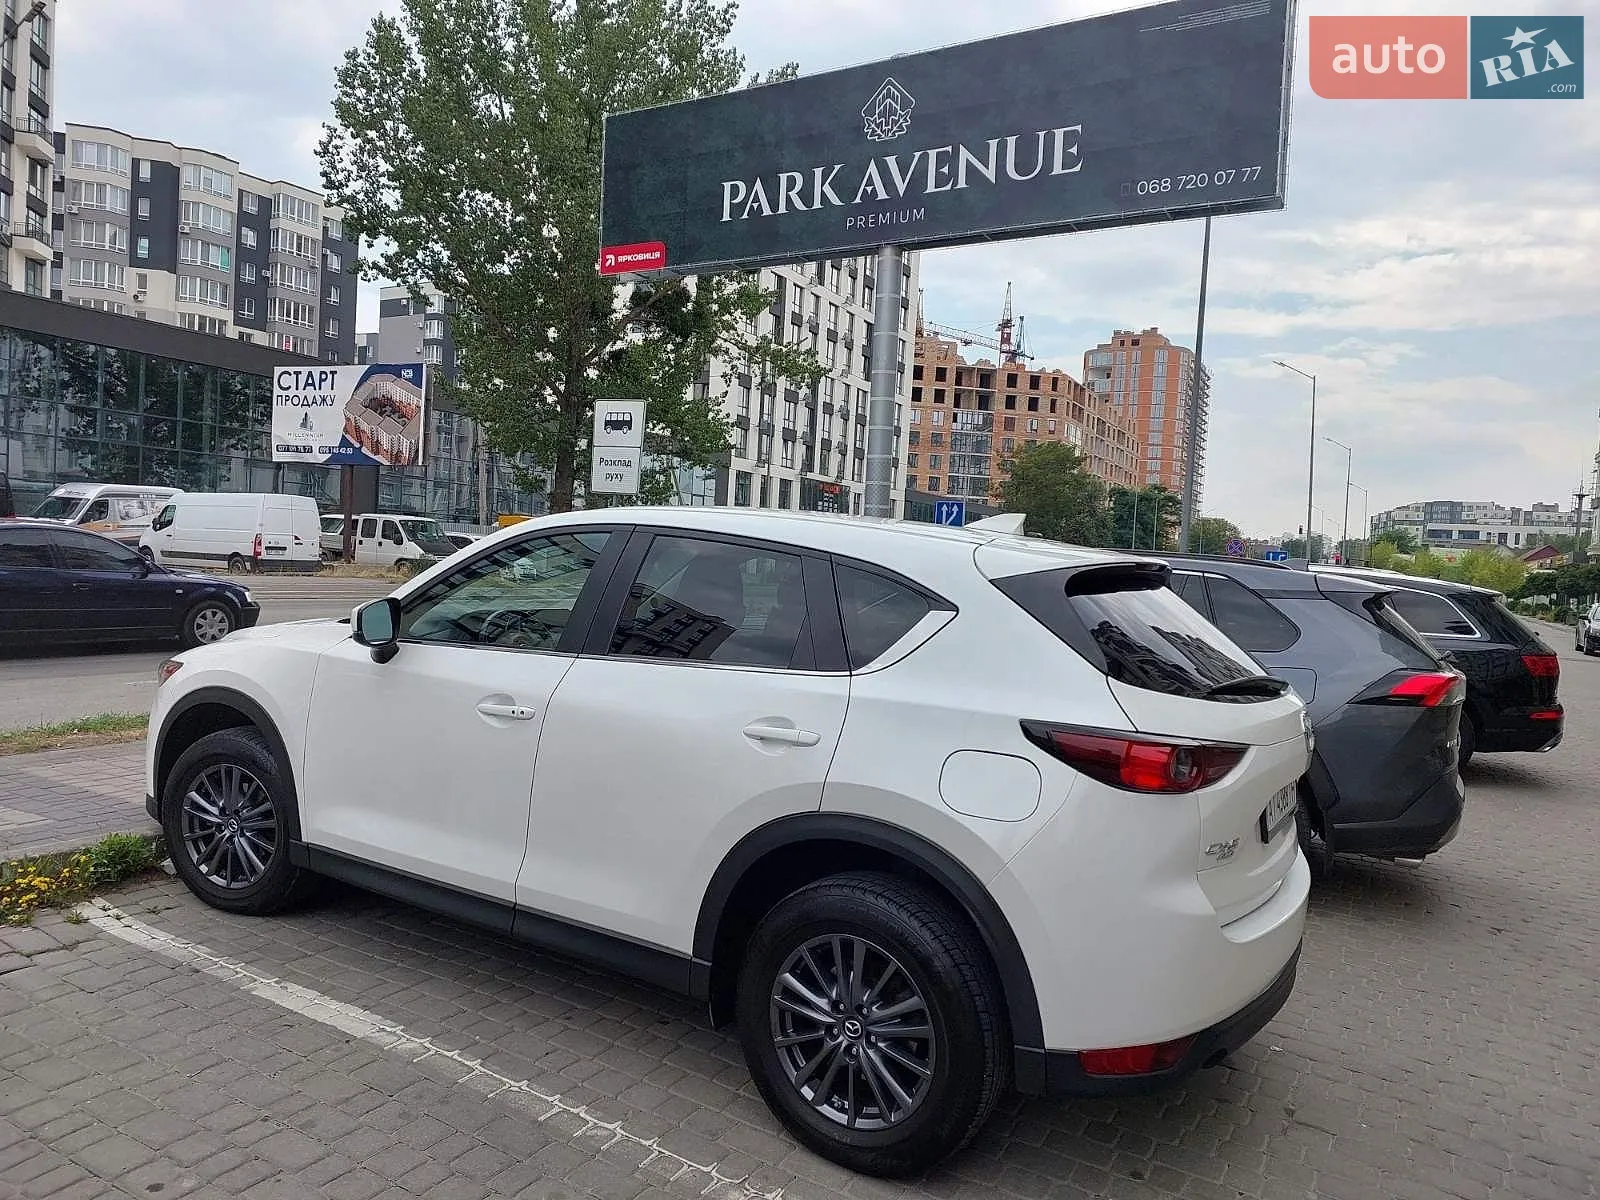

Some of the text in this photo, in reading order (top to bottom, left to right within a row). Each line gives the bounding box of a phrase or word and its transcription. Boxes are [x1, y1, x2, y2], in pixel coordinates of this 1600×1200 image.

[719, 124, 1084, 222] PARK AVENUE
[1137, 165, 1263, 195] 068 720 07 77
[846, 207, 926, 231] PREMIUM
[617, 251, 661, 263] ЯРКОВИЦЯ
[277, 370, 338, 392] СТАРТ
[276, 395, 336, 408] ПРОДАЖУ
[600, 457, 632, 468] Розклад
[605, 472, 624, 481] руху
